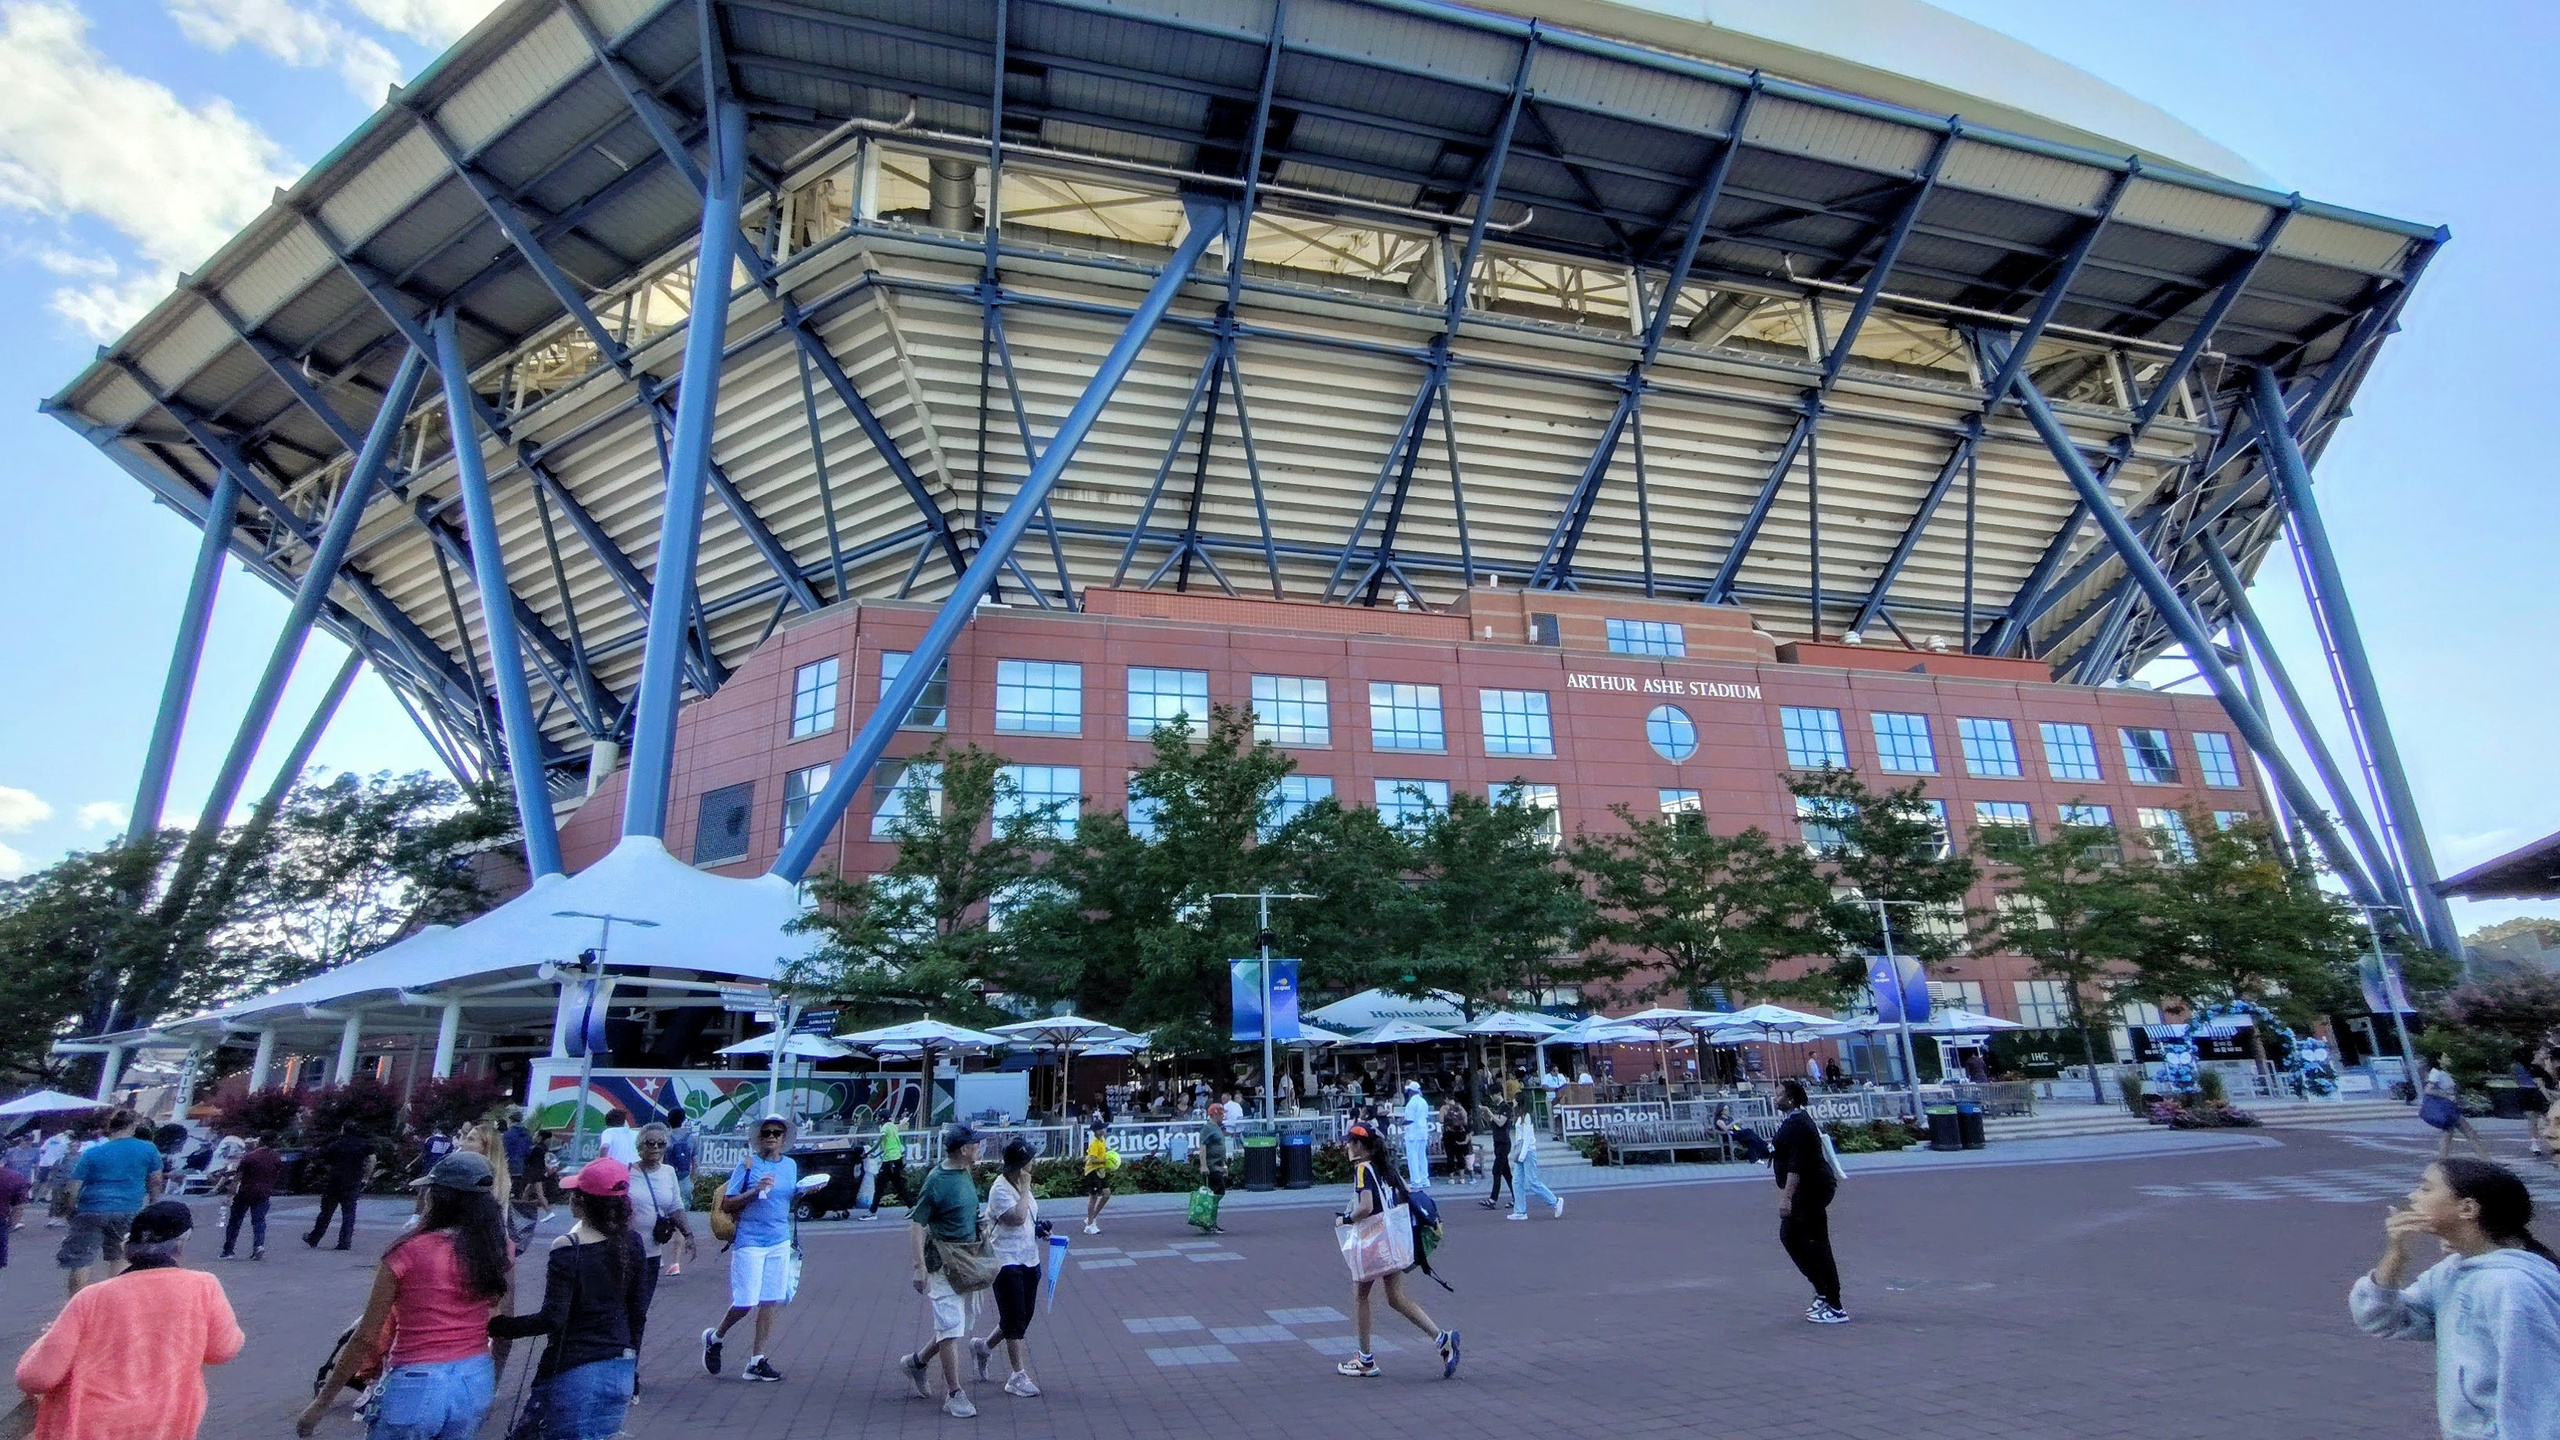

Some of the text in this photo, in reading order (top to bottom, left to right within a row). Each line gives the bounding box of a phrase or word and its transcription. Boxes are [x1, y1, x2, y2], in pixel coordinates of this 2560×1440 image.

[1566, 673, 1762, 699] ARTHUR ASHE STADIUM
[2031, 1052, 2049, 1061] IHG
[1565, 1107, 1660, 1130] Heineken
